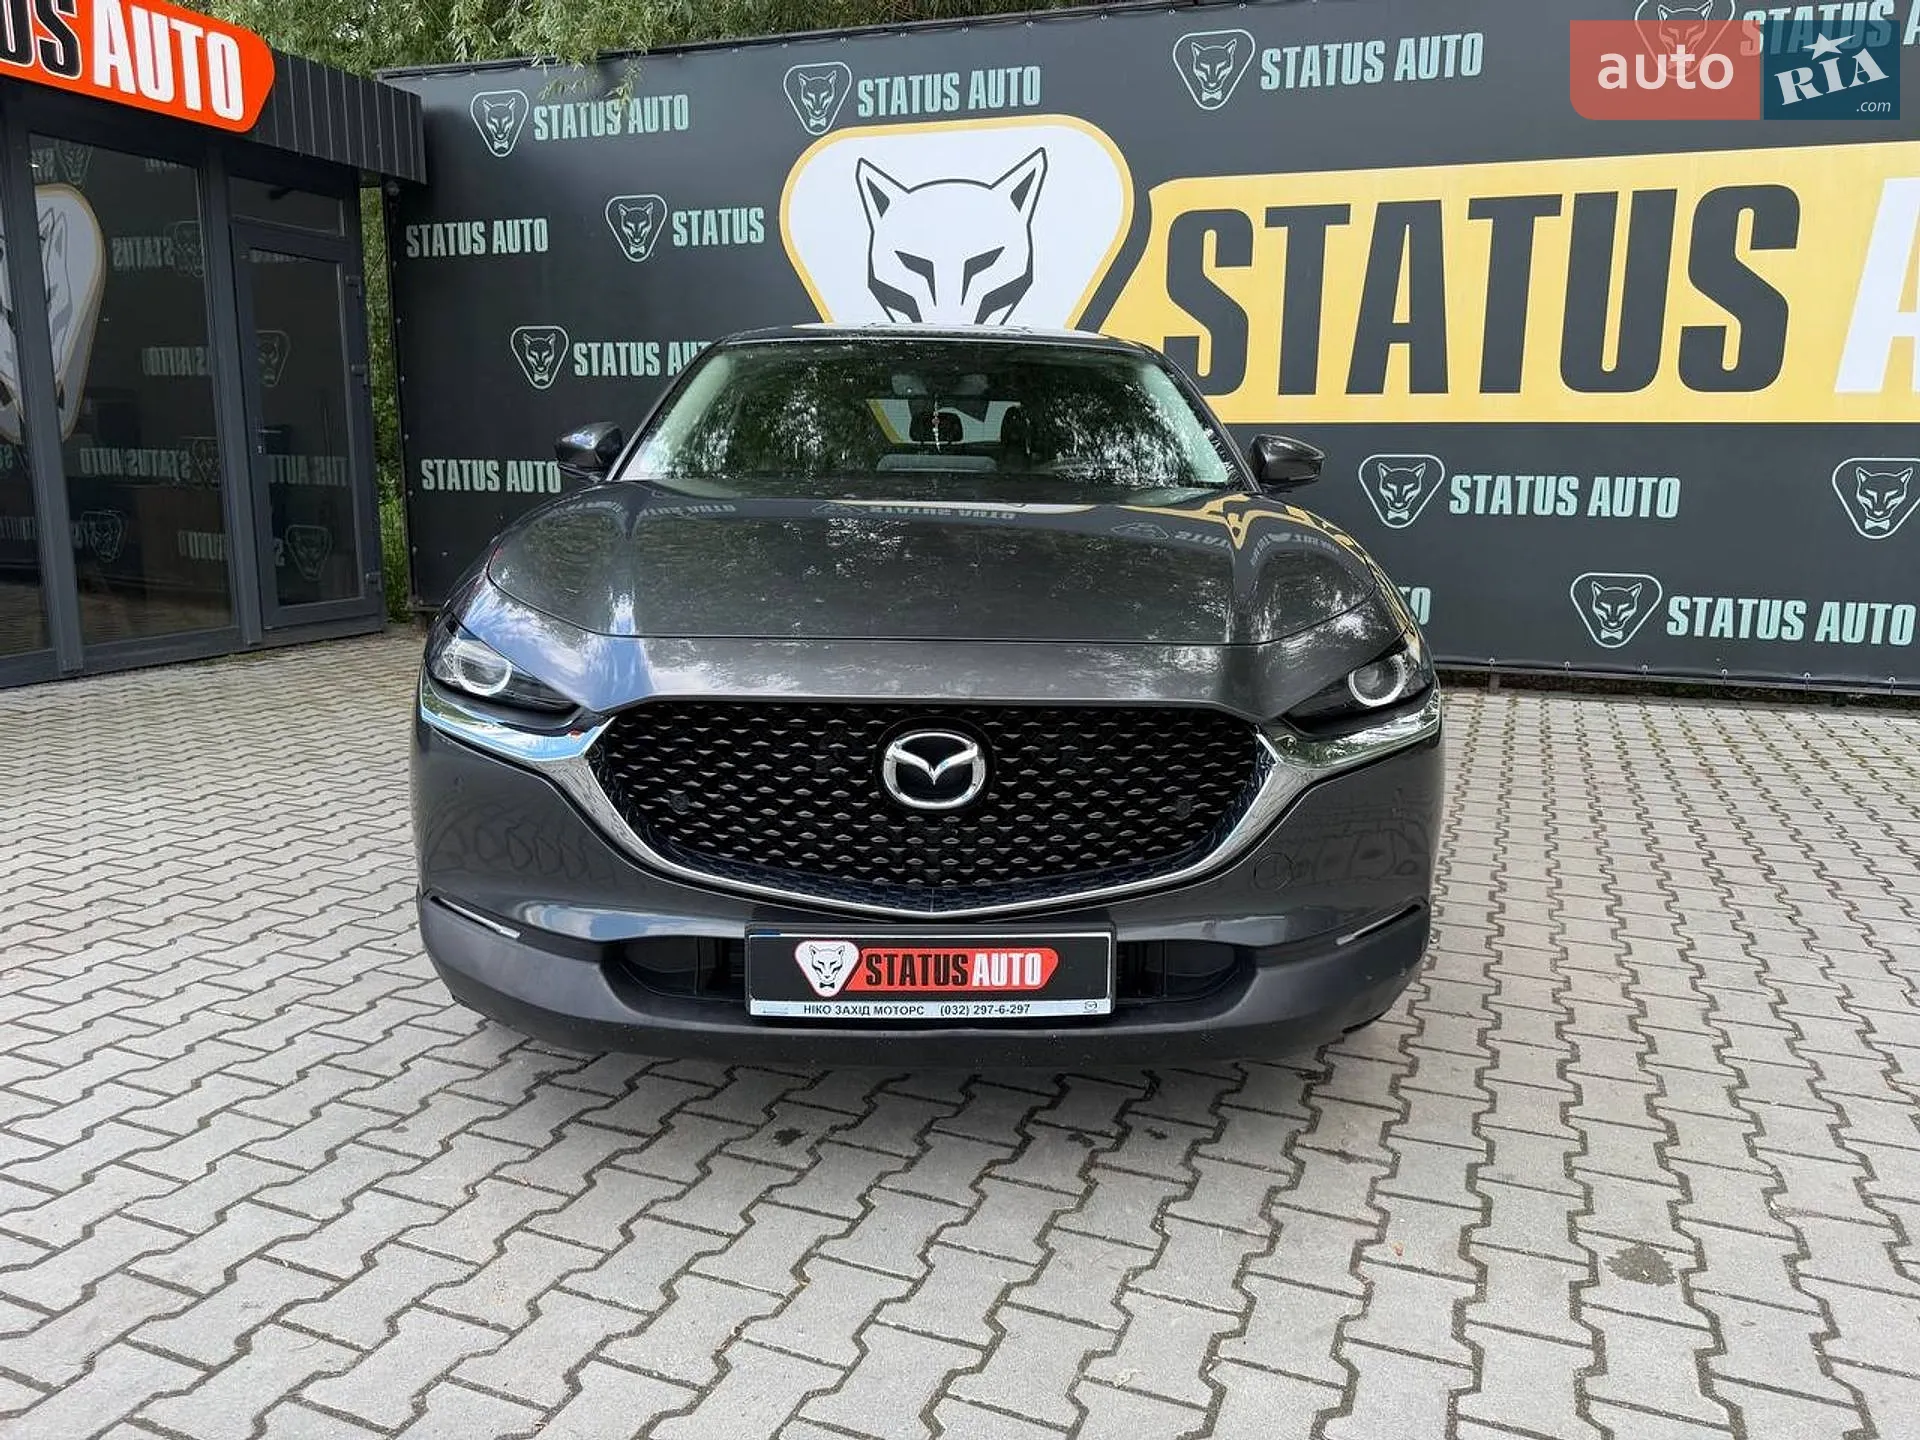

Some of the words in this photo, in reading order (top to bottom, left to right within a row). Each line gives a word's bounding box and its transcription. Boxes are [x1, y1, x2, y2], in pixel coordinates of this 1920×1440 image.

[1740, 0, 1895, 57] STATUS
[93, 0, 244, 121] AUTO
[1260, 40, 1386, 90] STATUS
[1394, 32, 1484, 82] AUTO
[857, 72, 960, 118] STATUS
[968, 66, 1042, 110] AUTO
[533, 100, 622, 141] STATUS
[628, 94, 689, 134] AUTO
[406, 221, 486, 258] STATUS
[492, 217, 549, 255] AUTO
[671, 207, 765, 248] STATUS
[1163, 184, 1800, 395] STATUS
[573, 341, 660, 377] STATUS
[421, 459, 500, 492] STATUS
[506, 459, 562, 494] AUTO
[1449, 475, 1579, 517] STATUS
[1587, 476, 1681, 519] AUTO
[1666, 595, 1808, 641] STATUS
[1814, 601, 1918, 646] AUTO
[865, 953, 969, 987] STATUS
[971, 952, 1043, 987] AUTO
[803, 1004, 832, 1016] НІКО
[834, 1004, 871, 1017] ЗАХІД
[873, 1005, 925, 1016] МОТОРС
[940, 1004, 969, 1017] (032)
[973, 1004, 1031, 1016] 297-6-297
